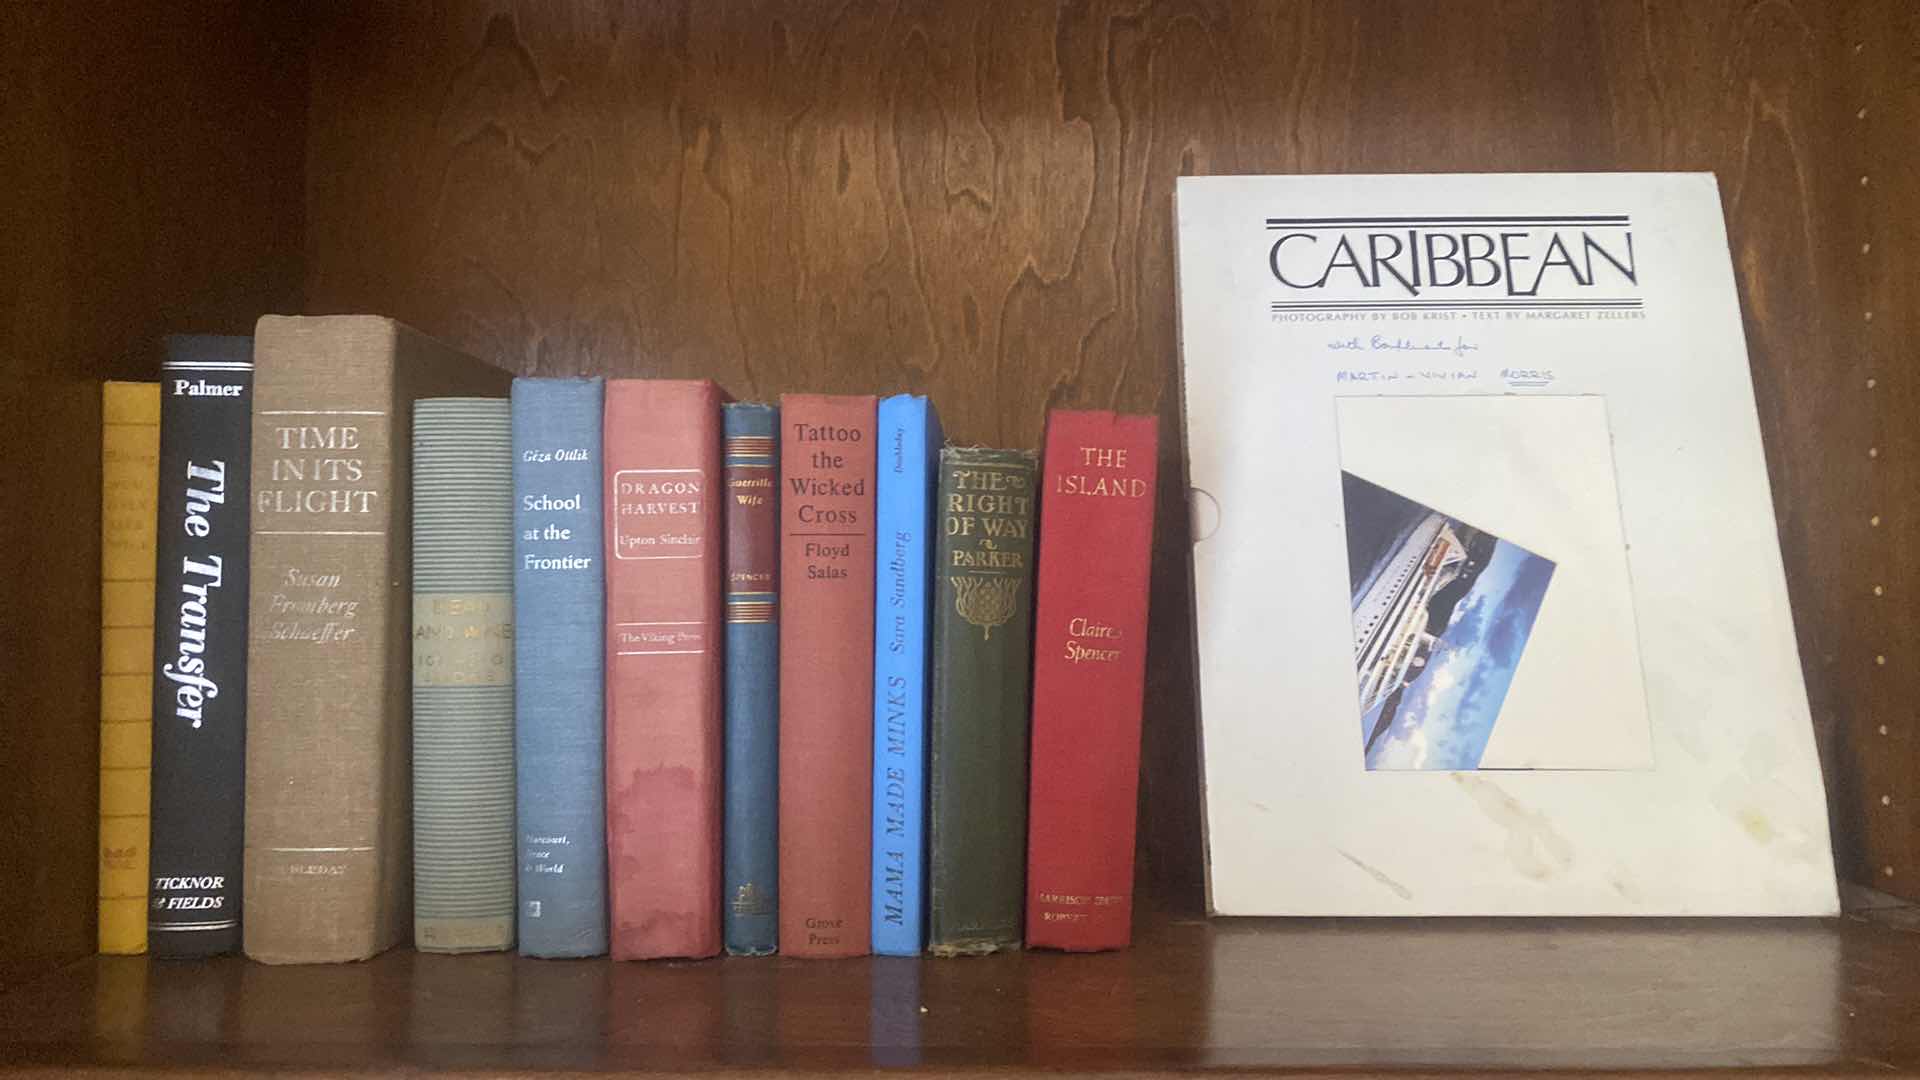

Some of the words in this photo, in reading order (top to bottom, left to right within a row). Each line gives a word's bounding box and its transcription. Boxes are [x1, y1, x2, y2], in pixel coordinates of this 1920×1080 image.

[1269, 229, 1638, 297] CARIBBEAN
[1271, 312, 1367, 322] PHOTOGRAPHY
[1370, 312, 1386, 321] BY
[1392, 311, 1417, 320] BOB
[1423, 311, 1456, 320] KRIST
[1473, 311, 1500, 320] TEXT
[1506, 311, 1521, 320] BY
[1526, 311, 1591, 320] MARGARET
[1597, 310, 1646, 320] ZELLERS
[1336, 370, 1399, 384] MARTIN
[1499, 367, 1556, 381] MORRIS
[173, 379, 243, 397] Palmer
[275, 426, 361, 450] TIME
[794, 423, 861, 442] Tattoo
[812, 452, 844, 468] the
[1080, 447, 1127, 468] THE
[272, 459, 306, 481] IN
[313, 459, 363, 481] ITS
[621, 482, 700, 495] DRAGON
[789, 478, 864, 496] Wicked
[952, 470, 1008, 491] THE
[1057, 475, 1147, 497] ISLAND
[184, 460, 225, 537] The
[257, 490, 378, 513] FLIGHT
[523, 494, 581, 511] School
[621, 502, 701, 514] HARVEST
[737, 495, 763, 507] Wife
[949, 493, 1029, 514] RIGHT
[798, 504, 857, 524] Cross
[523, 528, 540, 540] at
[544, 523, 571, 540] the
[945, 516, 976, 535] OF
[982, 518, 1029, 538] WAY
[620, 535, 656, 549] Upton
[805, 543, 849, 560] Floyd
[525, 554, 592, 570] Frontier
[952, 550, 1024, 568] PARKER
[283, 568, 342, 588] Susan
[807, 565, 848, 580] Salas
[888, 531, 912, 607] Sandberg
[163, 555, 222, 728] Transfer
[618, 631, 640, 644] The
[889, 615, 905, 655] Sara
[1064, 640, 1120, 664] Spencer
[887, 675, 906, 756] MINKS
[886, 767, 905, 838] MADE
[155, 876, 225, 890] TICKNOR
[884, 851, 904, 926] MAMA
[167, 896, 224, 910] FIELDS
